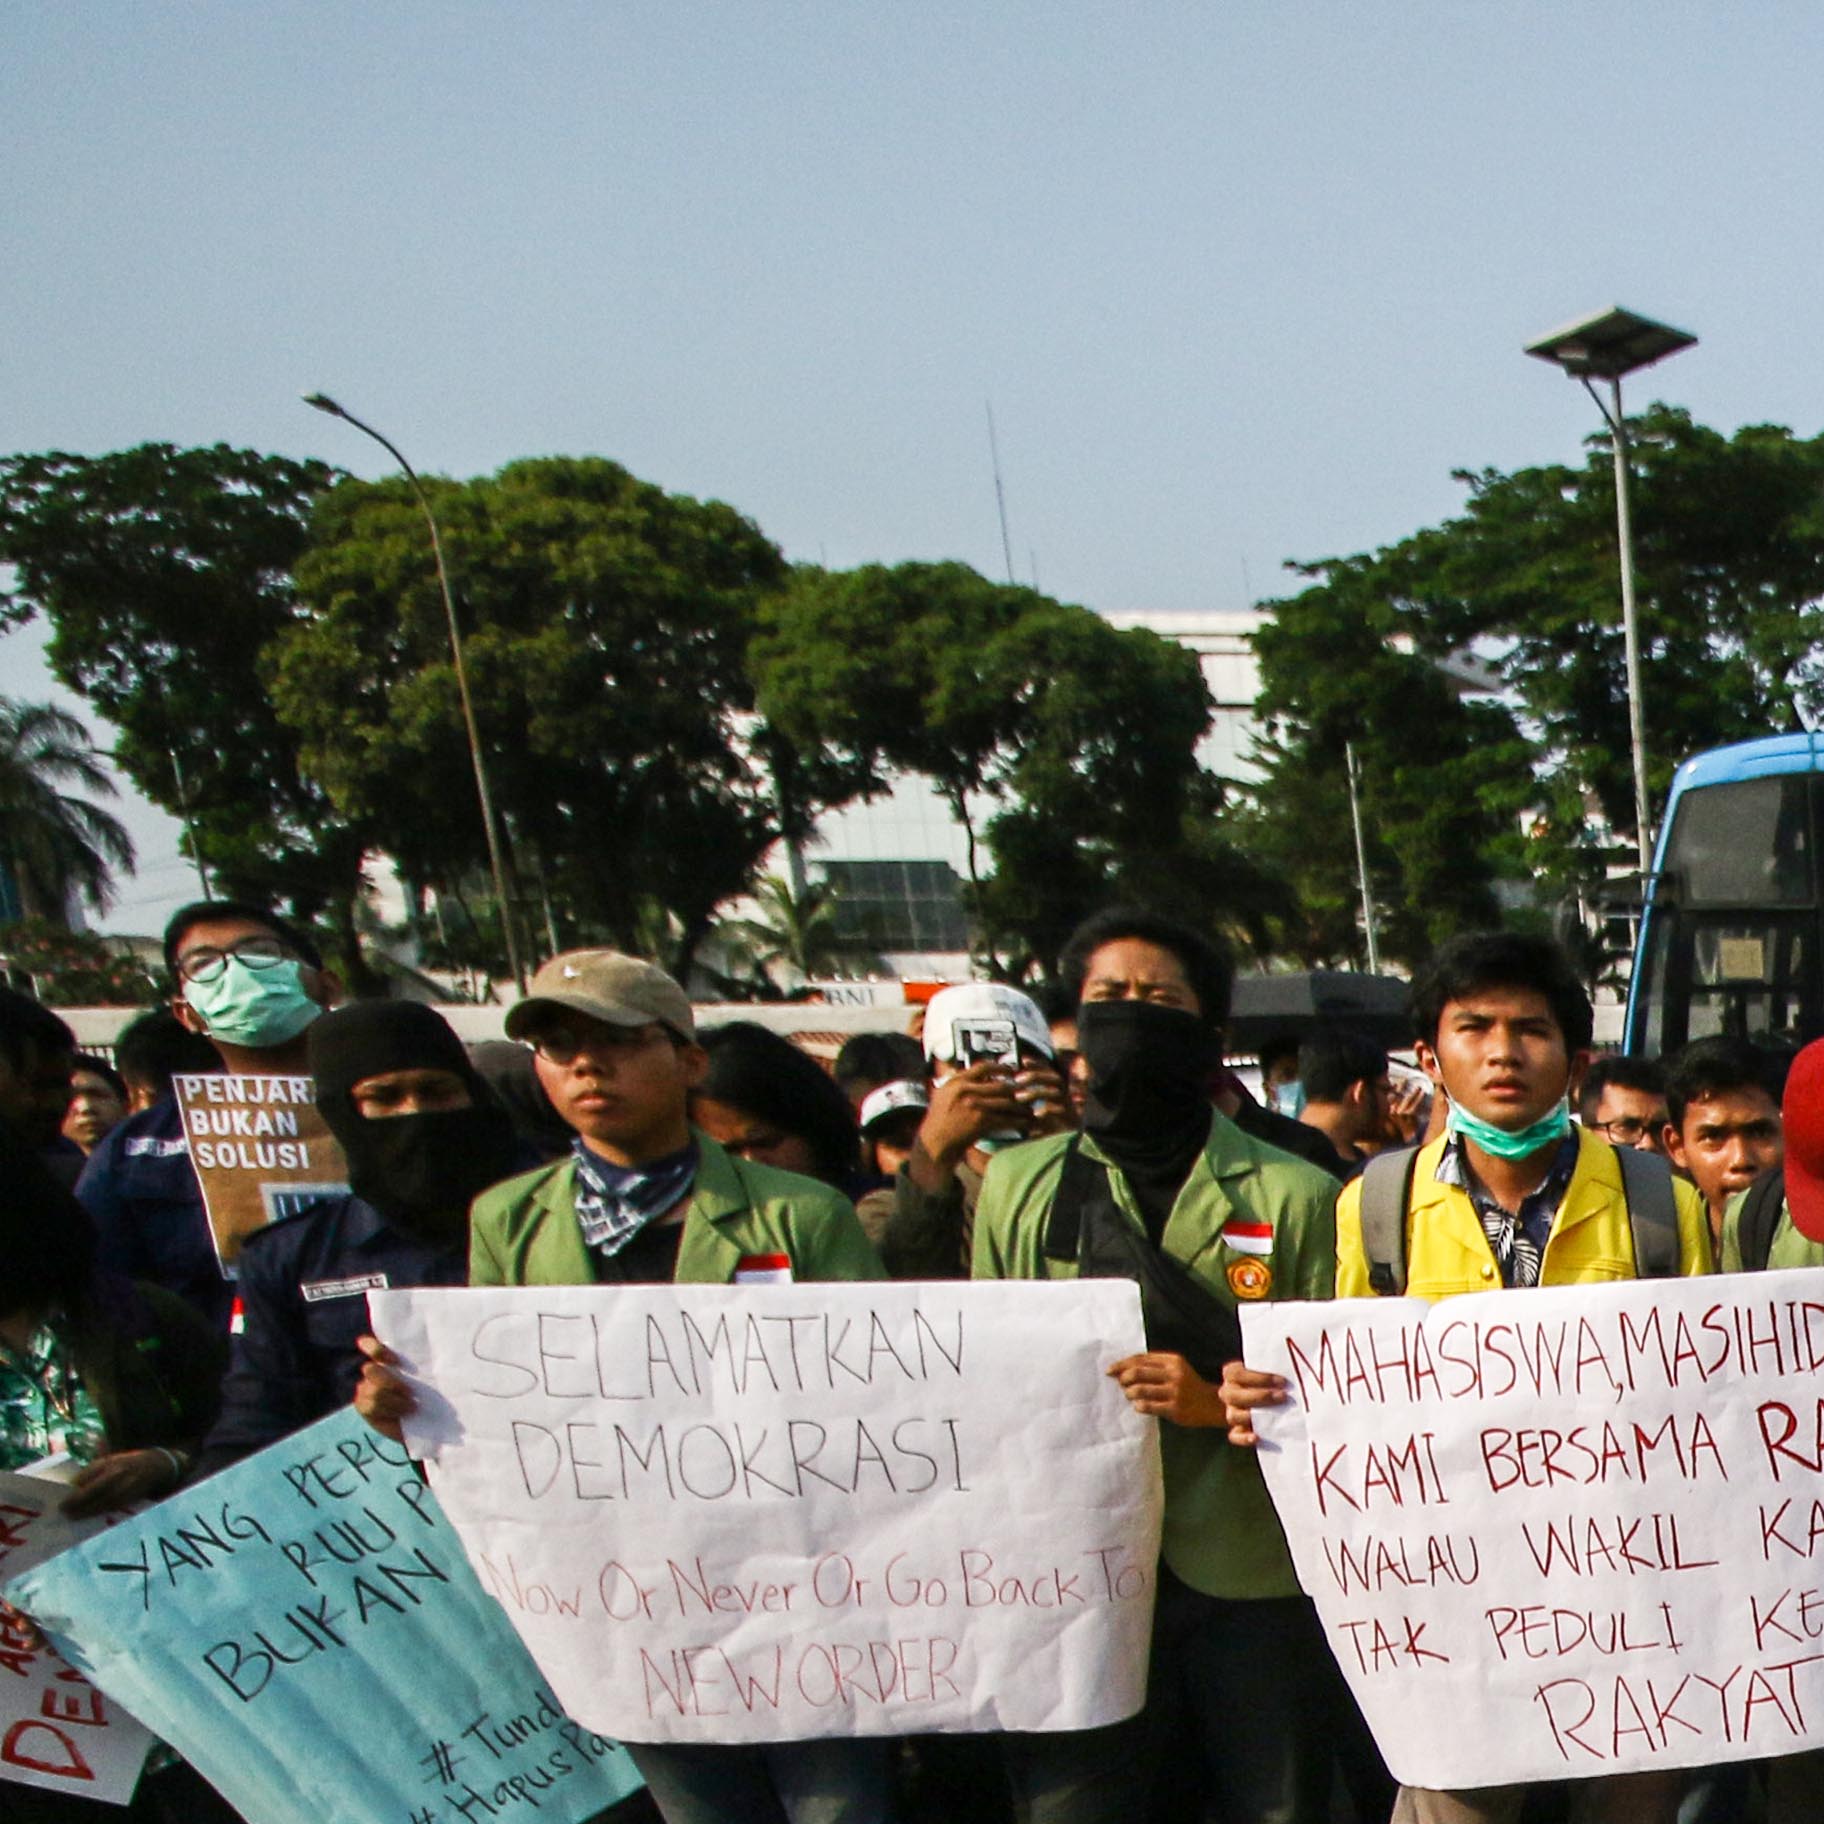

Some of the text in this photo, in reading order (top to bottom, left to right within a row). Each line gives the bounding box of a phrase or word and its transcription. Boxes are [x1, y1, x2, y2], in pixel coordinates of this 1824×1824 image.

[182, 1077, 316, 1104] PENJAR
[188, 1108, 298, 1137] BUKAN
[196, 1141, 311, 1168] SOLUSI
[470, 1309, 964, 1400] SELAMATKAN
[510, 1417, 973, 1502] DEMOKRASI
[1312, 1431, 1450, 1517] KAMI
[1479, 1411, 1727, 1493] BERSAMA
[100, 1503, 274, 1610] YANG
[281, 1507, 397, 1587] RUU
[482, 1544, 1146, 1623] Now Or Never Or Go Back To
[1322, 1534, 1480, 1597] WALAU
[1521, 1512, 1720, 1579] WAKIL
[202, 1547, 450, 1702] BUKAN
[1338, 1615, 1451, 1677] TAK
[1485, 1601, 1685, 1661] PEDULI
[640, 1636, 961, 1721] NEW ORDER
